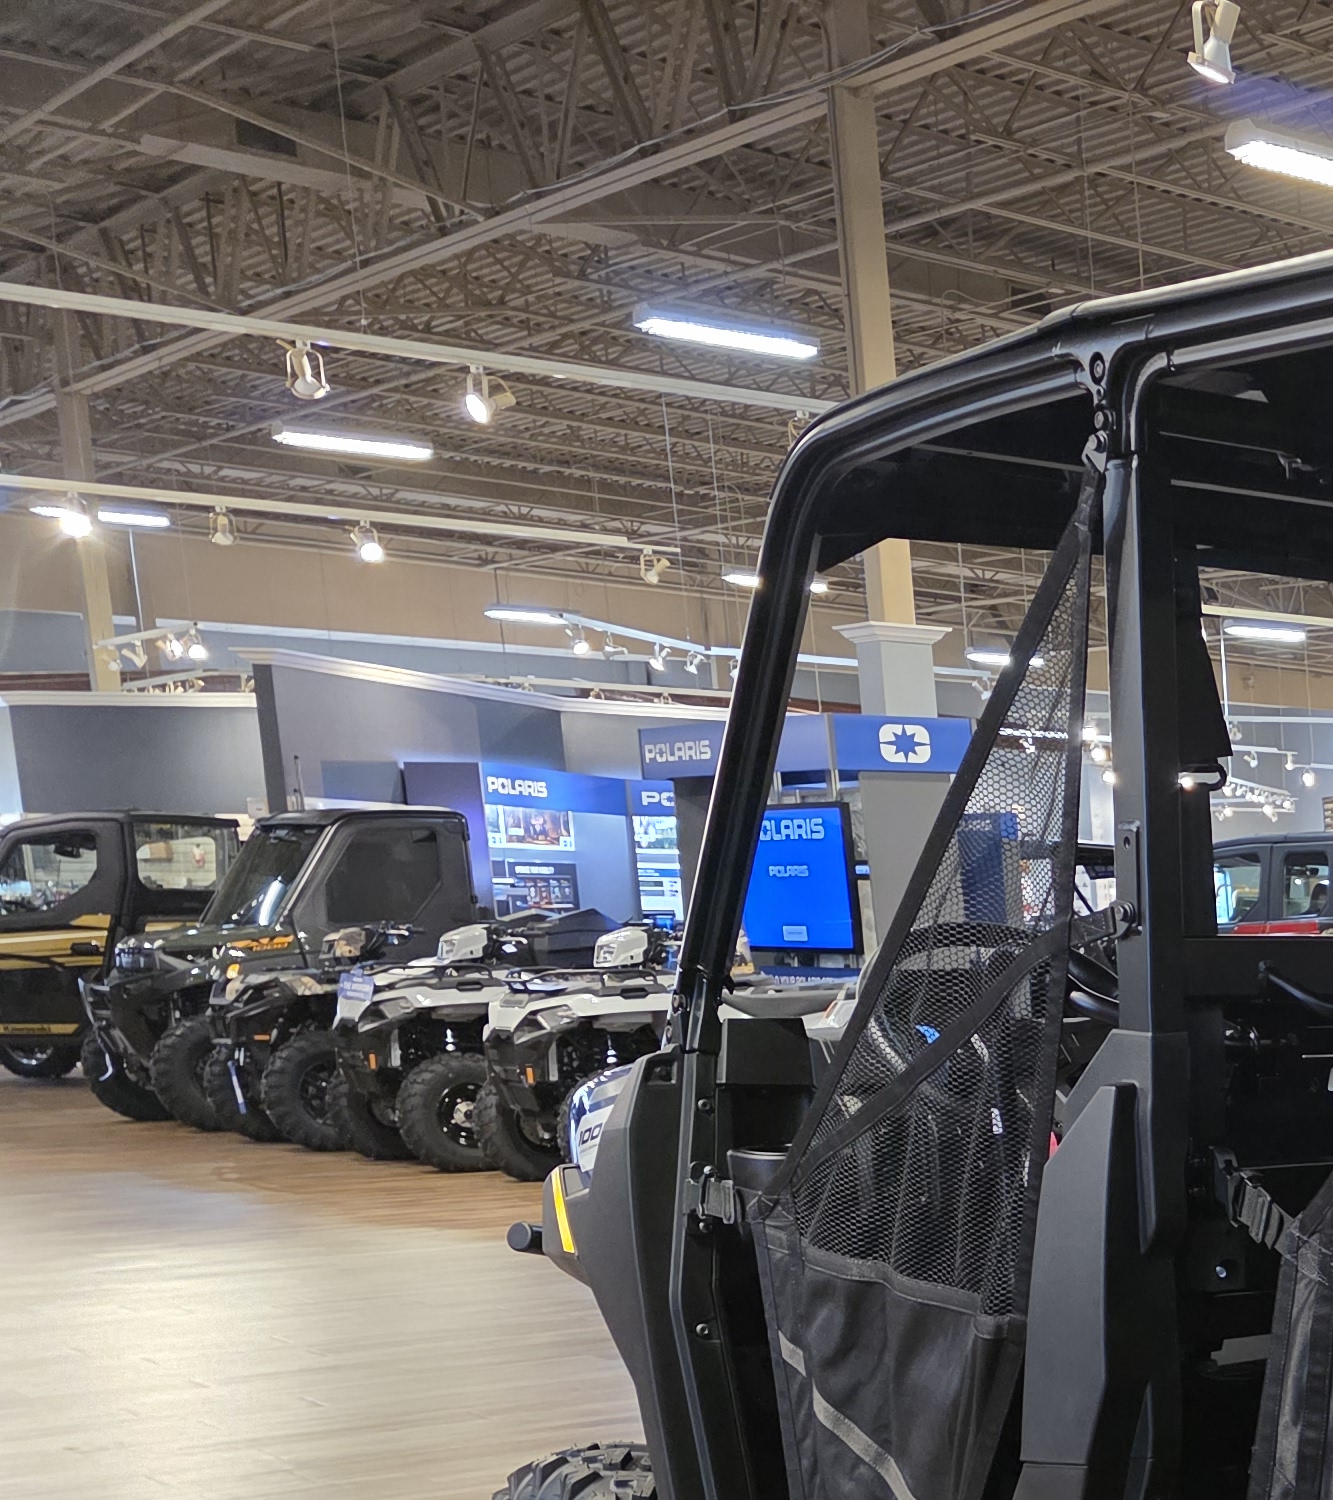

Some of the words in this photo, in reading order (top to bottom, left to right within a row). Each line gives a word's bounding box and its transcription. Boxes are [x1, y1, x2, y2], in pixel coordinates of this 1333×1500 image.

[644, 740, 712, 763] POLARIS
[486, 776, 548, 798] POLARIS
[760, 818, 825, 841] OLARIS
[769, 865, 809, 877] POLARIS
